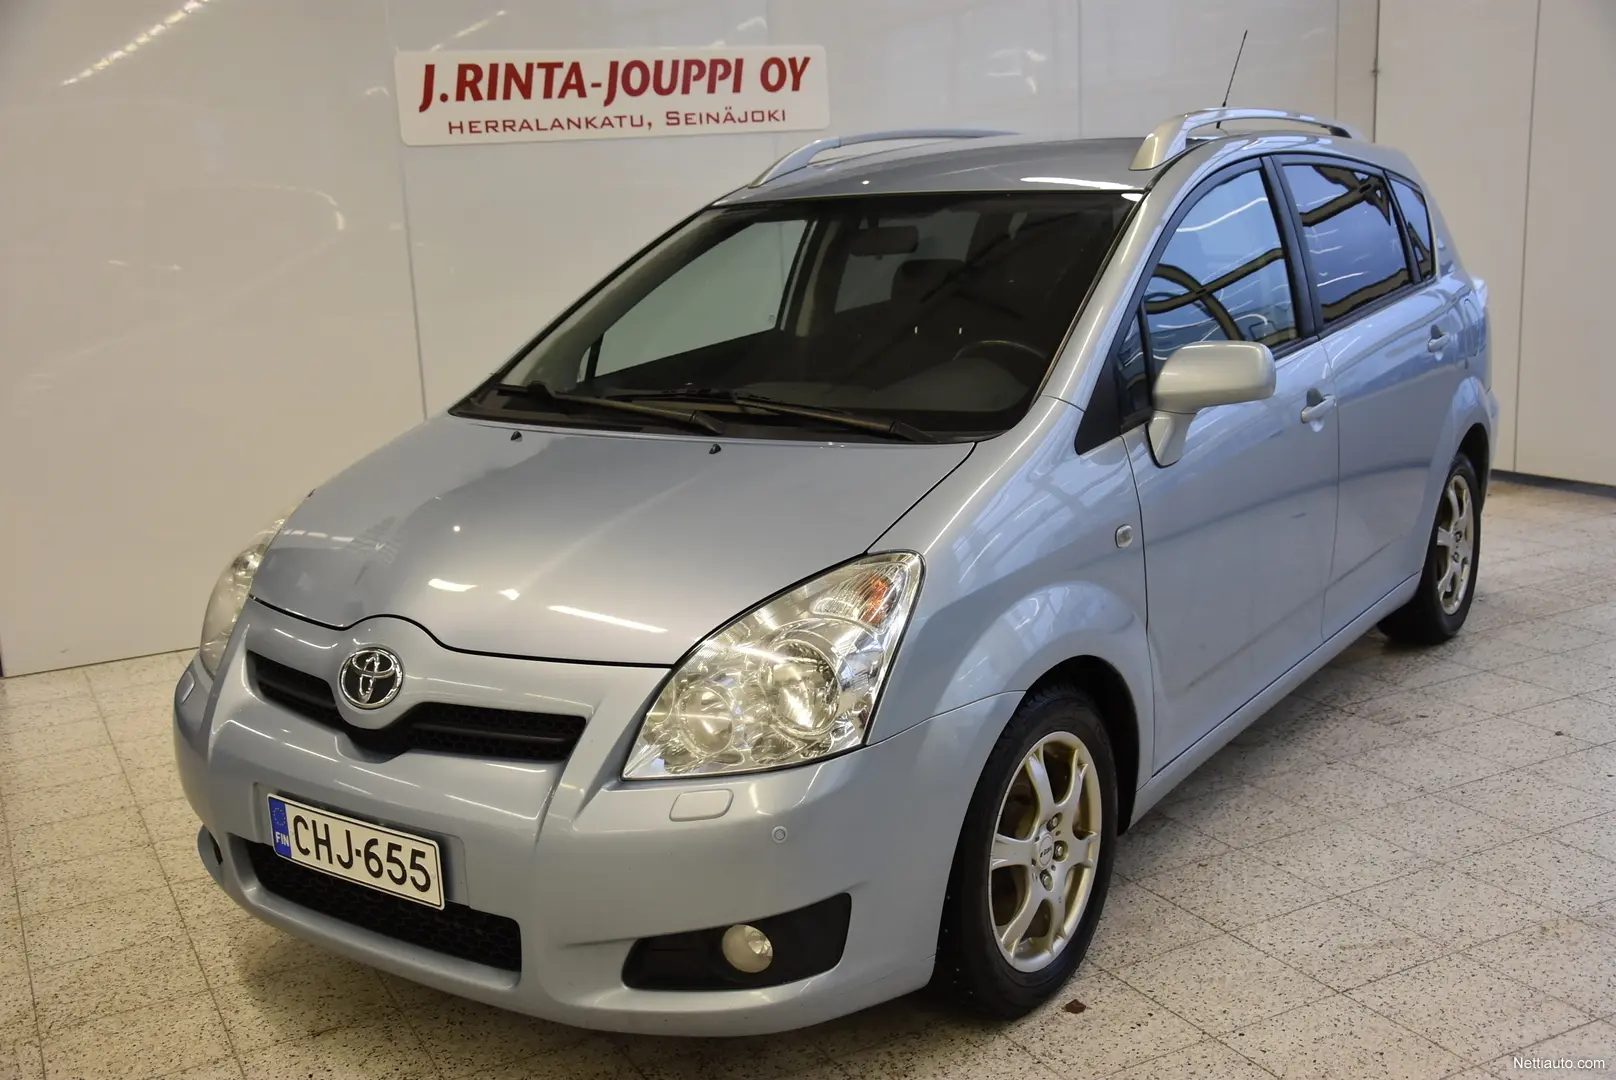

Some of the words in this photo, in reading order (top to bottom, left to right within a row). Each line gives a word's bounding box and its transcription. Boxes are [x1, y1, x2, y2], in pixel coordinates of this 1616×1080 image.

[759, 56, 811, 93] OY
[448, 115, 653, 135] HERRALANKATU,
[665, 106, 786, 127] SEINÄJOKI
[275, 831, 290, 847] FIN
[293, 814, 431, 893] CHJ-655
